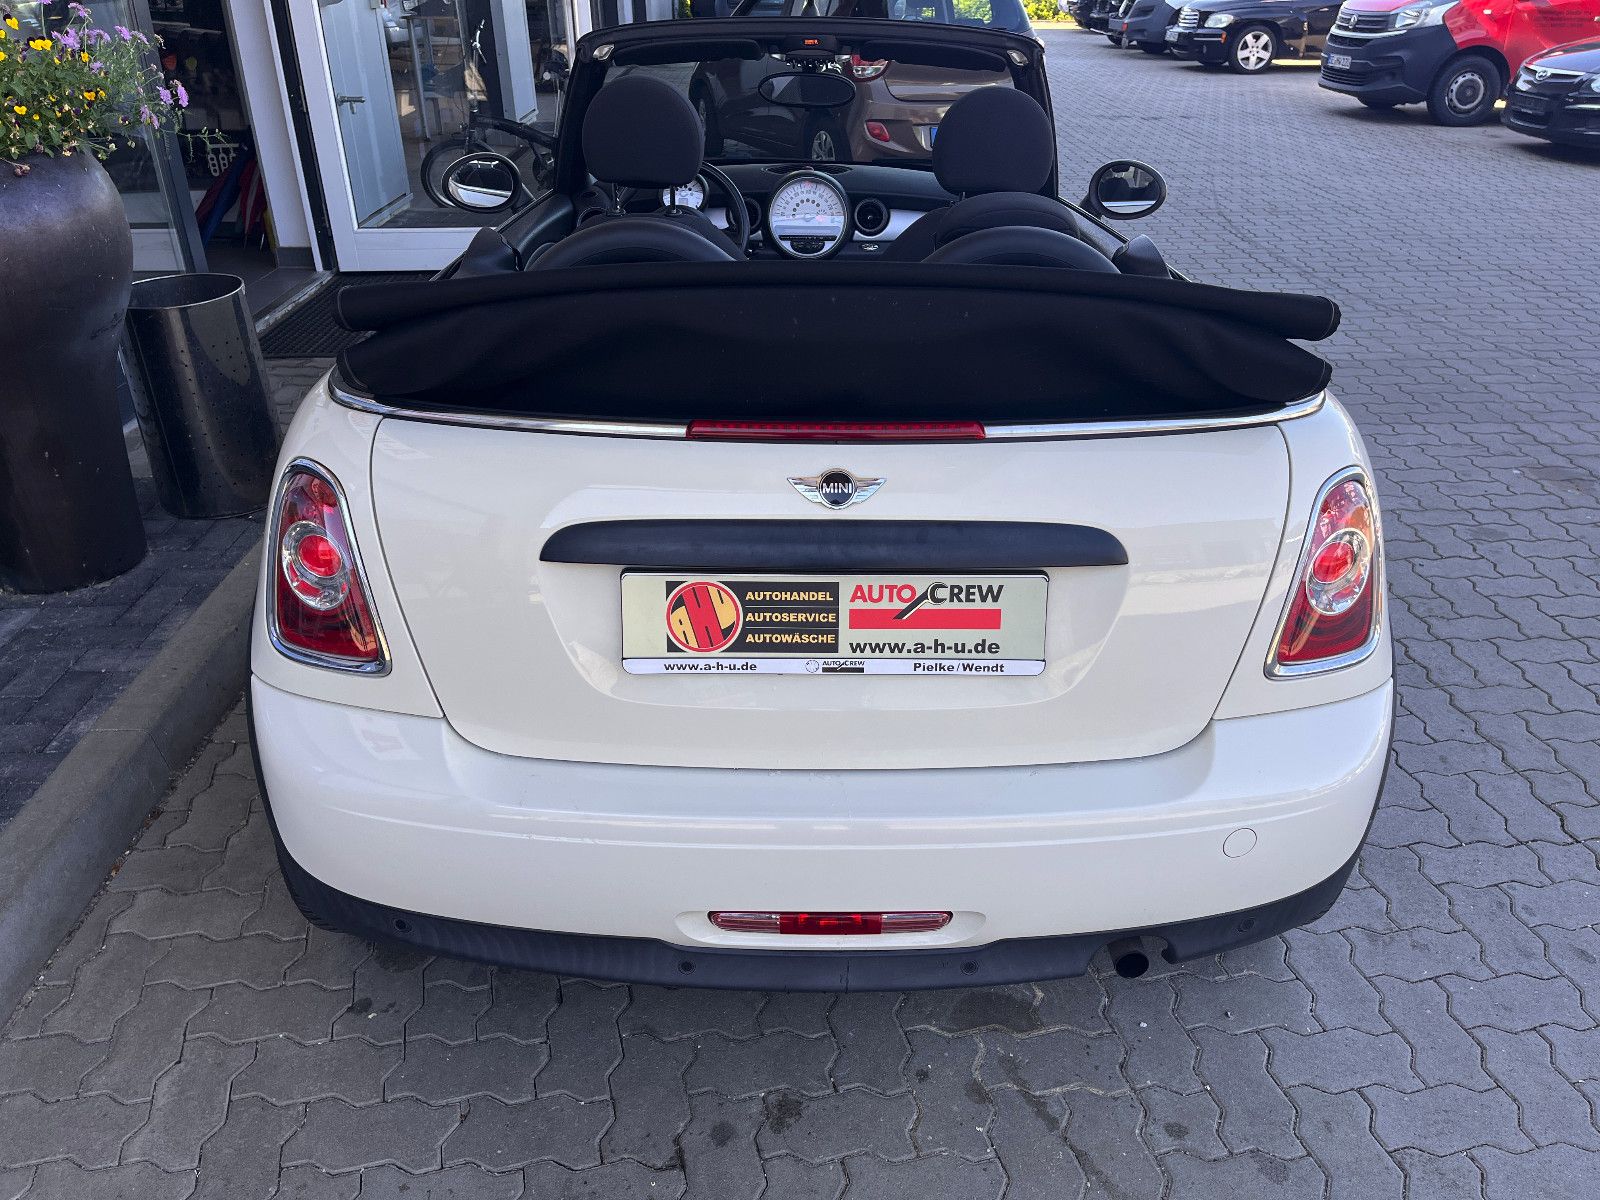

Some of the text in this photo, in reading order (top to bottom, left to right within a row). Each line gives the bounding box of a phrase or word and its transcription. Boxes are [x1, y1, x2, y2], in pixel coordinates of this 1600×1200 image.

[822, 482, 853, 494] MINI
[745, 591, 834, 601] AUTOHANDEL
[850, 584, 917, 603] AUTO
[745, 612, 837, 623] AUTOSERVICE
[745, 633, 836, 644] AUTOWÄSCHE
[849, 638, 1001, 655] www.a-h-u.de
[663, 661, 757, 671] www.a-h-u.de
